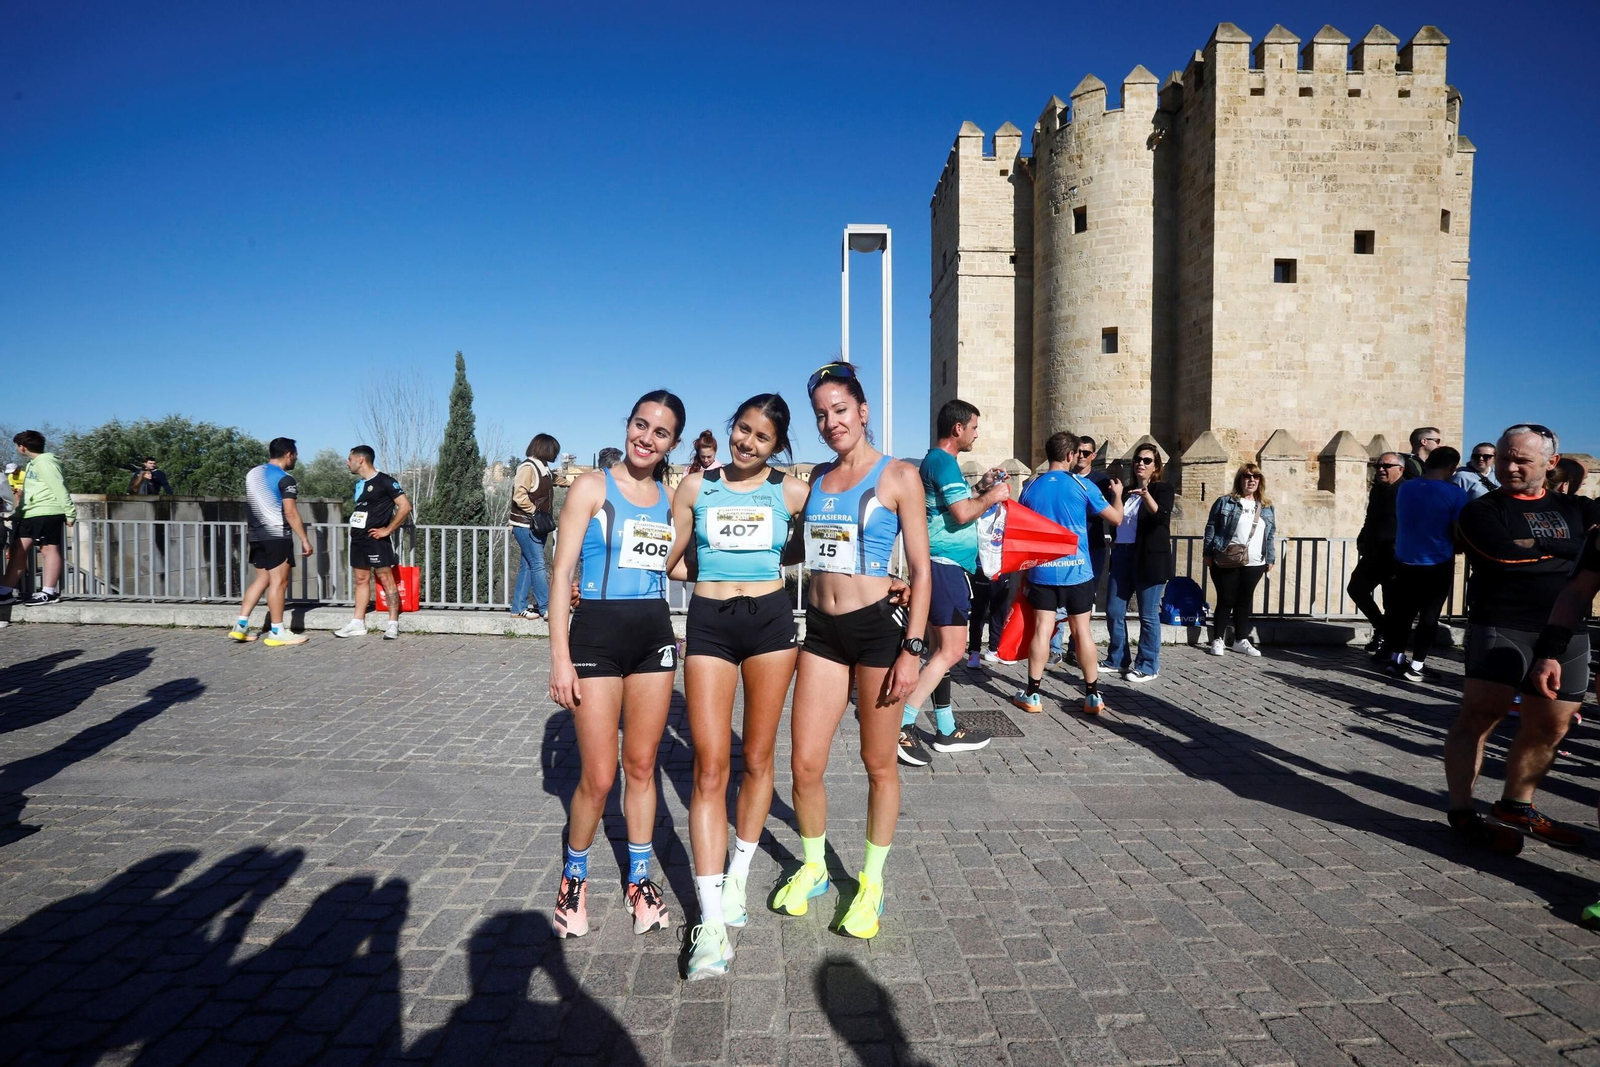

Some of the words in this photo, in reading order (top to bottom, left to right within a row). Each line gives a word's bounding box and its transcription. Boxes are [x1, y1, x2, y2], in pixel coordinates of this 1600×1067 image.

[806, 514, 853, 522] TROTASIERRA
[1524, 512, 1557, 521] RUN
[719, 524, 759, 537] 407
[1533, 528, 1565, 538] RUN
[632, 541, 668, 558] 408
[818, 543, 837, 558] 15
